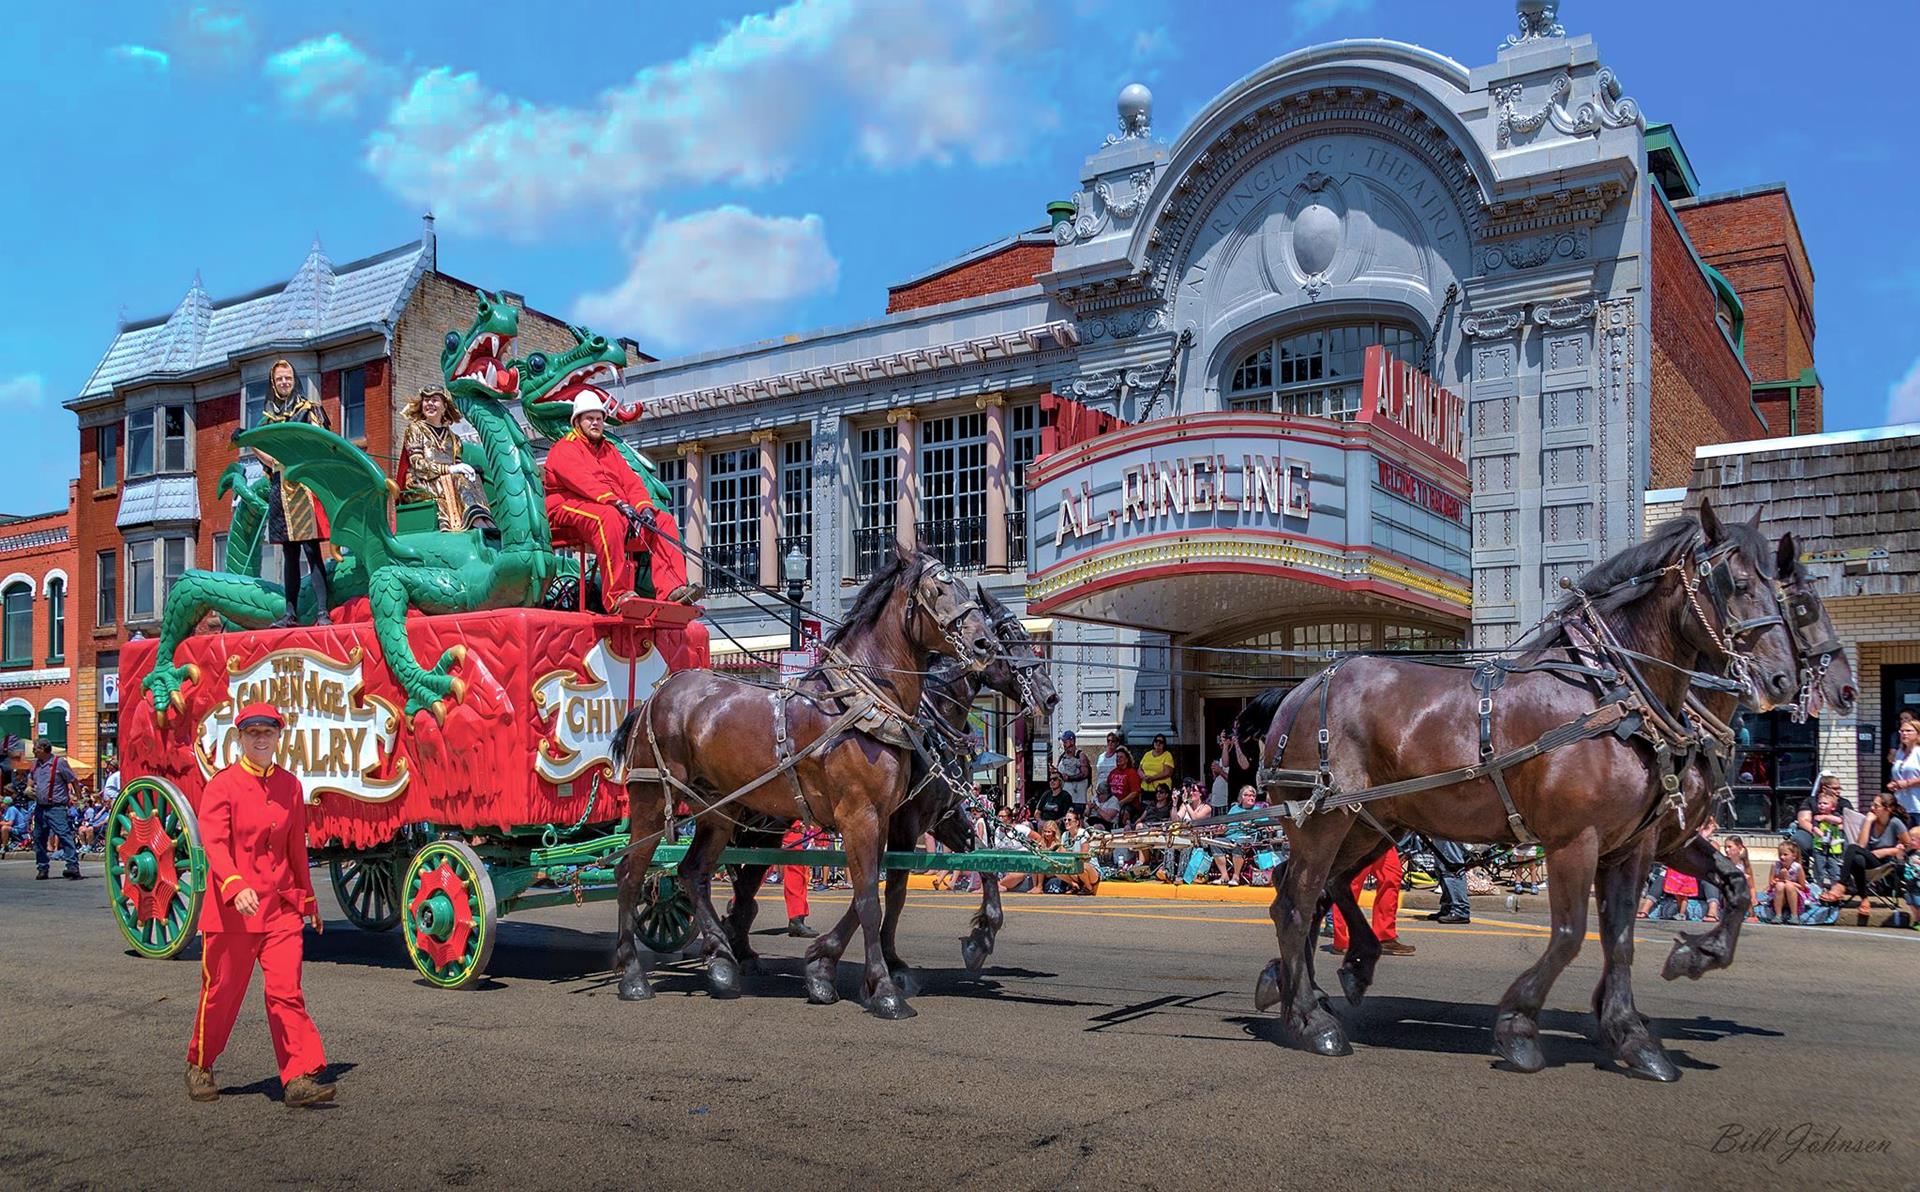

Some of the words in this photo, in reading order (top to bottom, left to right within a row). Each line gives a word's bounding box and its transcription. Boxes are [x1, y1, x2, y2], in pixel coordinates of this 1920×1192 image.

[1212, 144, 1333, 237] RINGLING
[1363, 146, 1458, 250] THEATRE
[1122, 454, 1312, 524] RINGLING
[1377, 459, 1417, 503] WELCOME
[271, 656, 304, 673] THE
[236, 669, 304, 714] GOLDEN
[304, 670, 347, 716] AGE
[566, 695, 642, 734] CHIV
[222, 727, 367, 774] CVALRY
